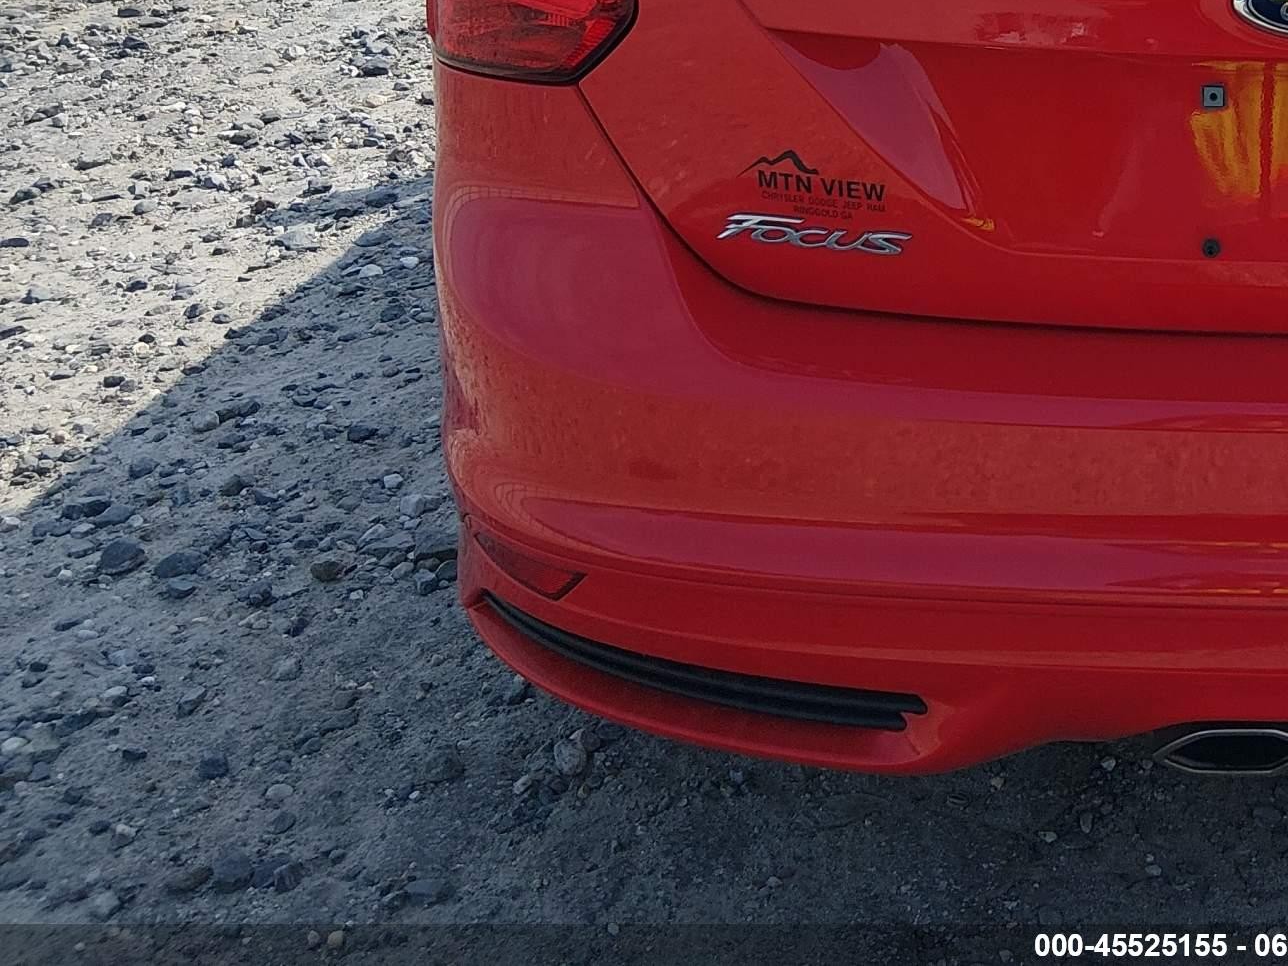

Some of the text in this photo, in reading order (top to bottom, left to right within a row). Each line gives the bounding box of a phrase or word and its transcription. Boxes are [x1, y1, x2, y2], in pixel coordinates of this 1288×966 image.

[757, 169, 886, 202] MTN VIEW
[762, 190, 804, 203] CHRYSLER
[808, 196, 838, 208] DODGE
[842, 200, 863, 211] JEEP
